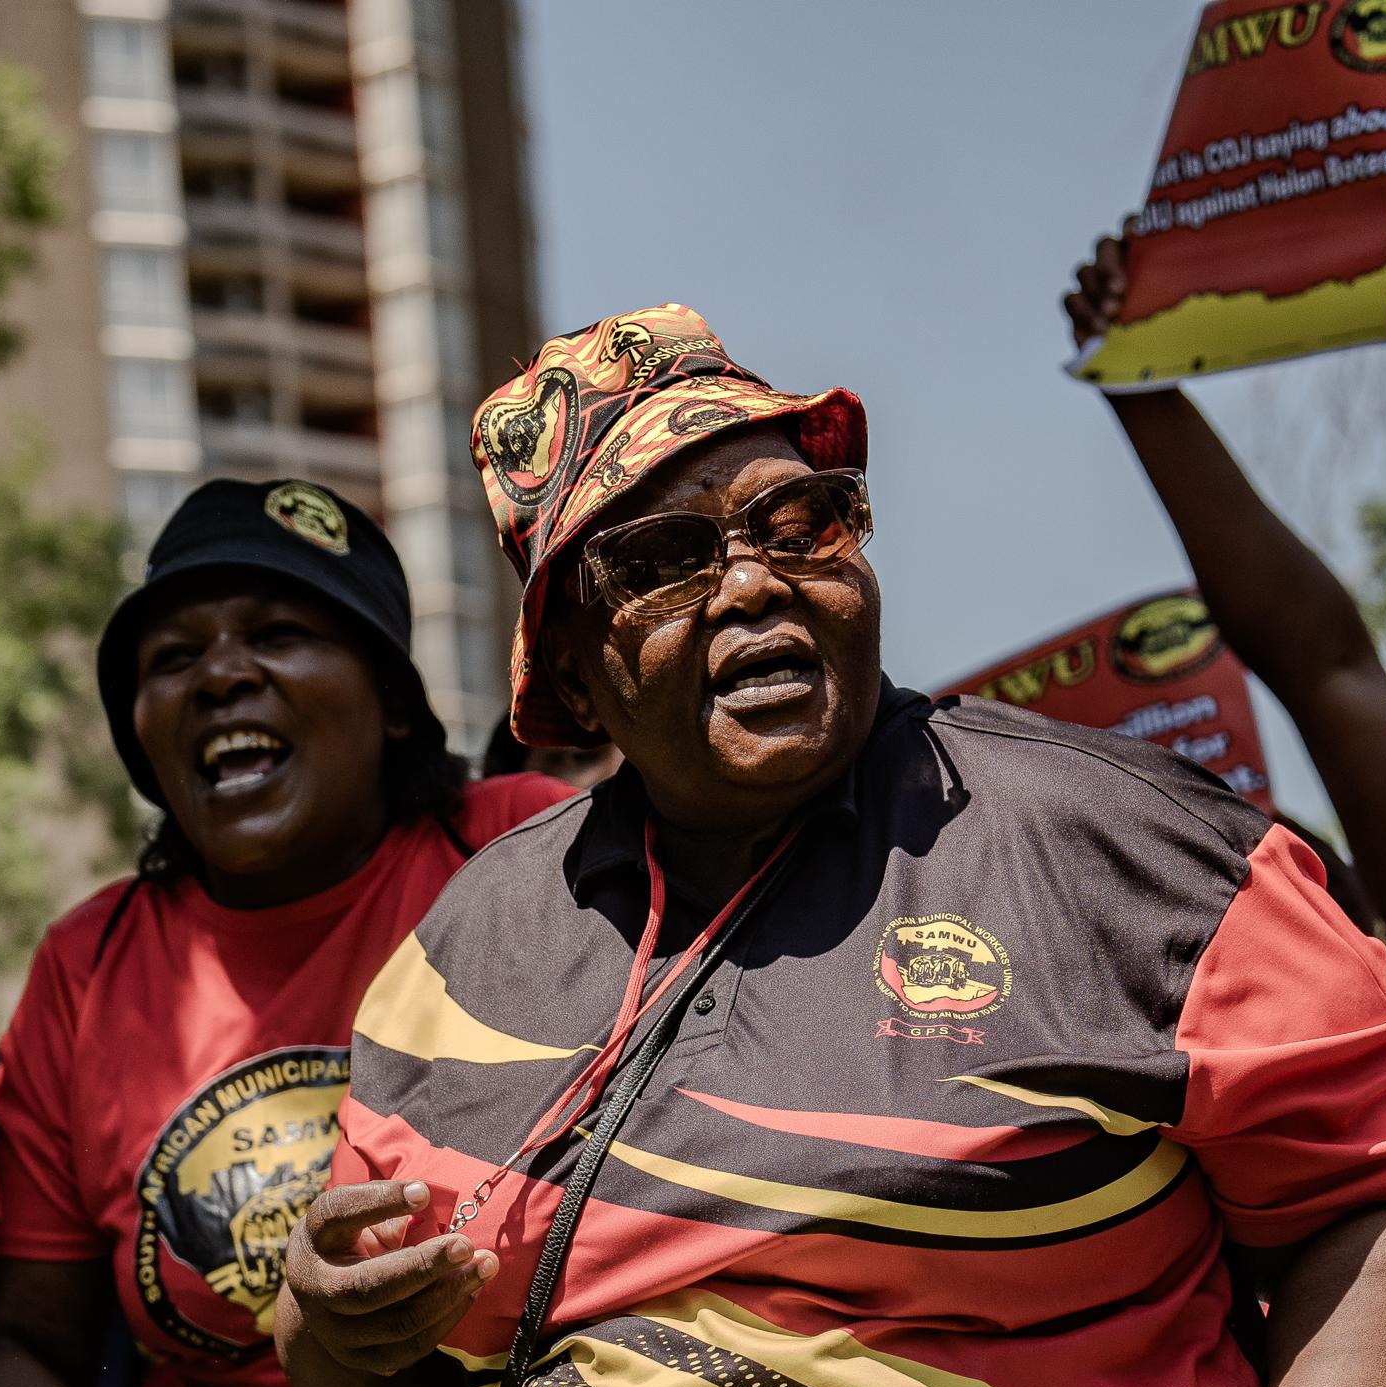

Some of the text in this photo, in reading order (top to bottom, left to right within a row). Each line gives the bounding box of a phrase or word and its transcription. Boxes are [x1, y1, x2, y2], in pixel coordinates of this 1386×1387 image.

[1186, 3, 1323, 74] MWU
[1204, 134, 1253, 173] COJ
[1174, 182, 1259, 229] against
[481, 419, 498, 465] AFRICAN
[565, 421, 576, 450] INJURY
[495, 468, 513, 494] SOUTH
[883, 916, 916, 938] AFRICAN
[917, 913, 973, 930] MUNICIPAL
[974, 926, 1011, 965] WORKERS'
[1001, 968, 1013, 997] UNION
[914, 930, 978, 949] SAMWU
[898, 1001, 909, 1012] TO
[909, 1010, 928, 1019] ONE
[980, 1007, 990, 1016] TO
[142, 1099, 221, 1205] AFRICAN
[232, 1110, 341, 1153] SAMW
